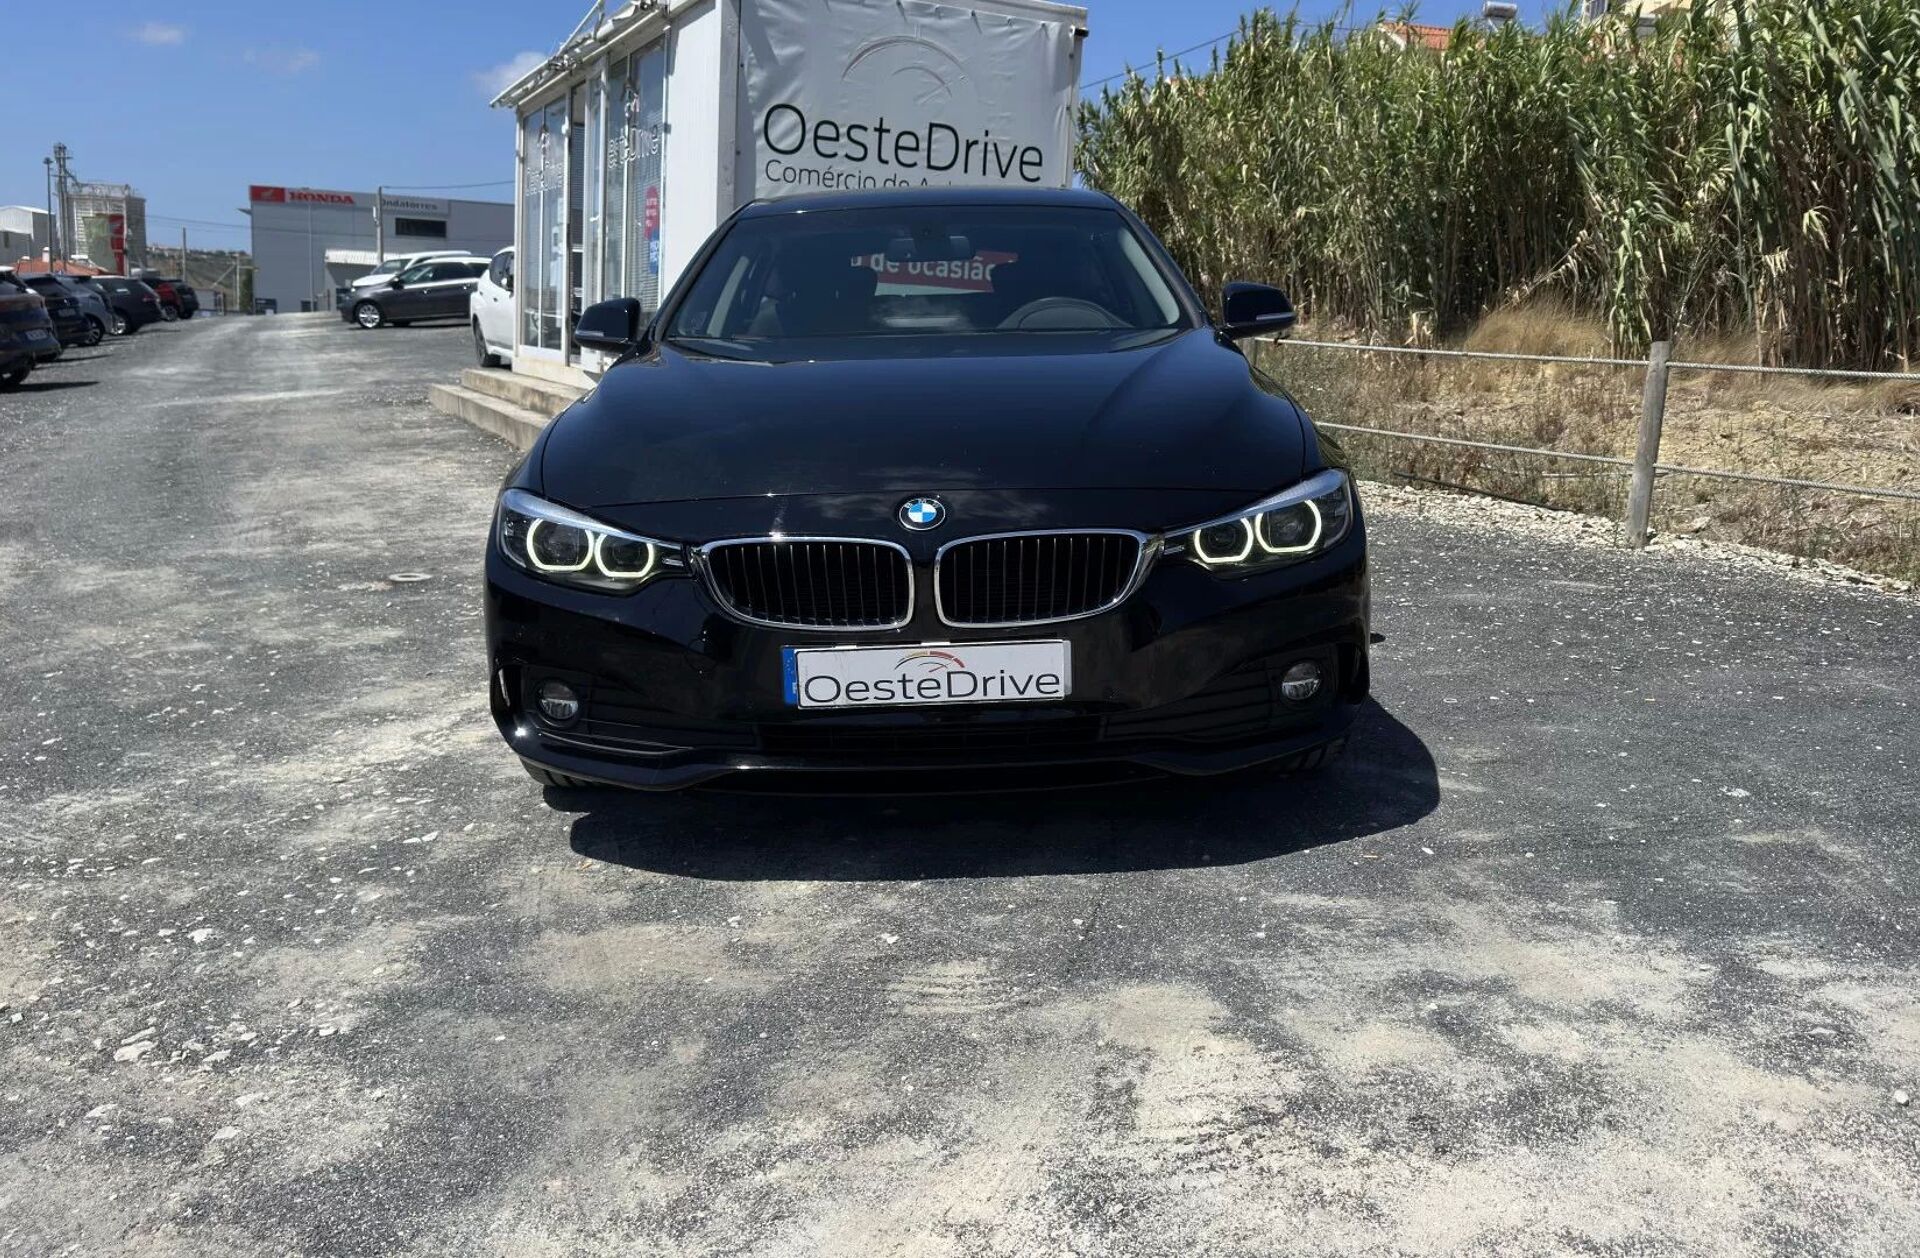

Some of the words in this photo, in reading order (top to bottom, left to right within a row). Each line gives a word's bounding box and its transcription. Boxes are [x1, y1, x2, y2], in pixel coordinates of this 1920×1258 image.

[763, 103, 1043, 183] OesteDrive
[289, 190, 355, 205] HONDA
[804, 669, 1060, 703] OesteDrive
